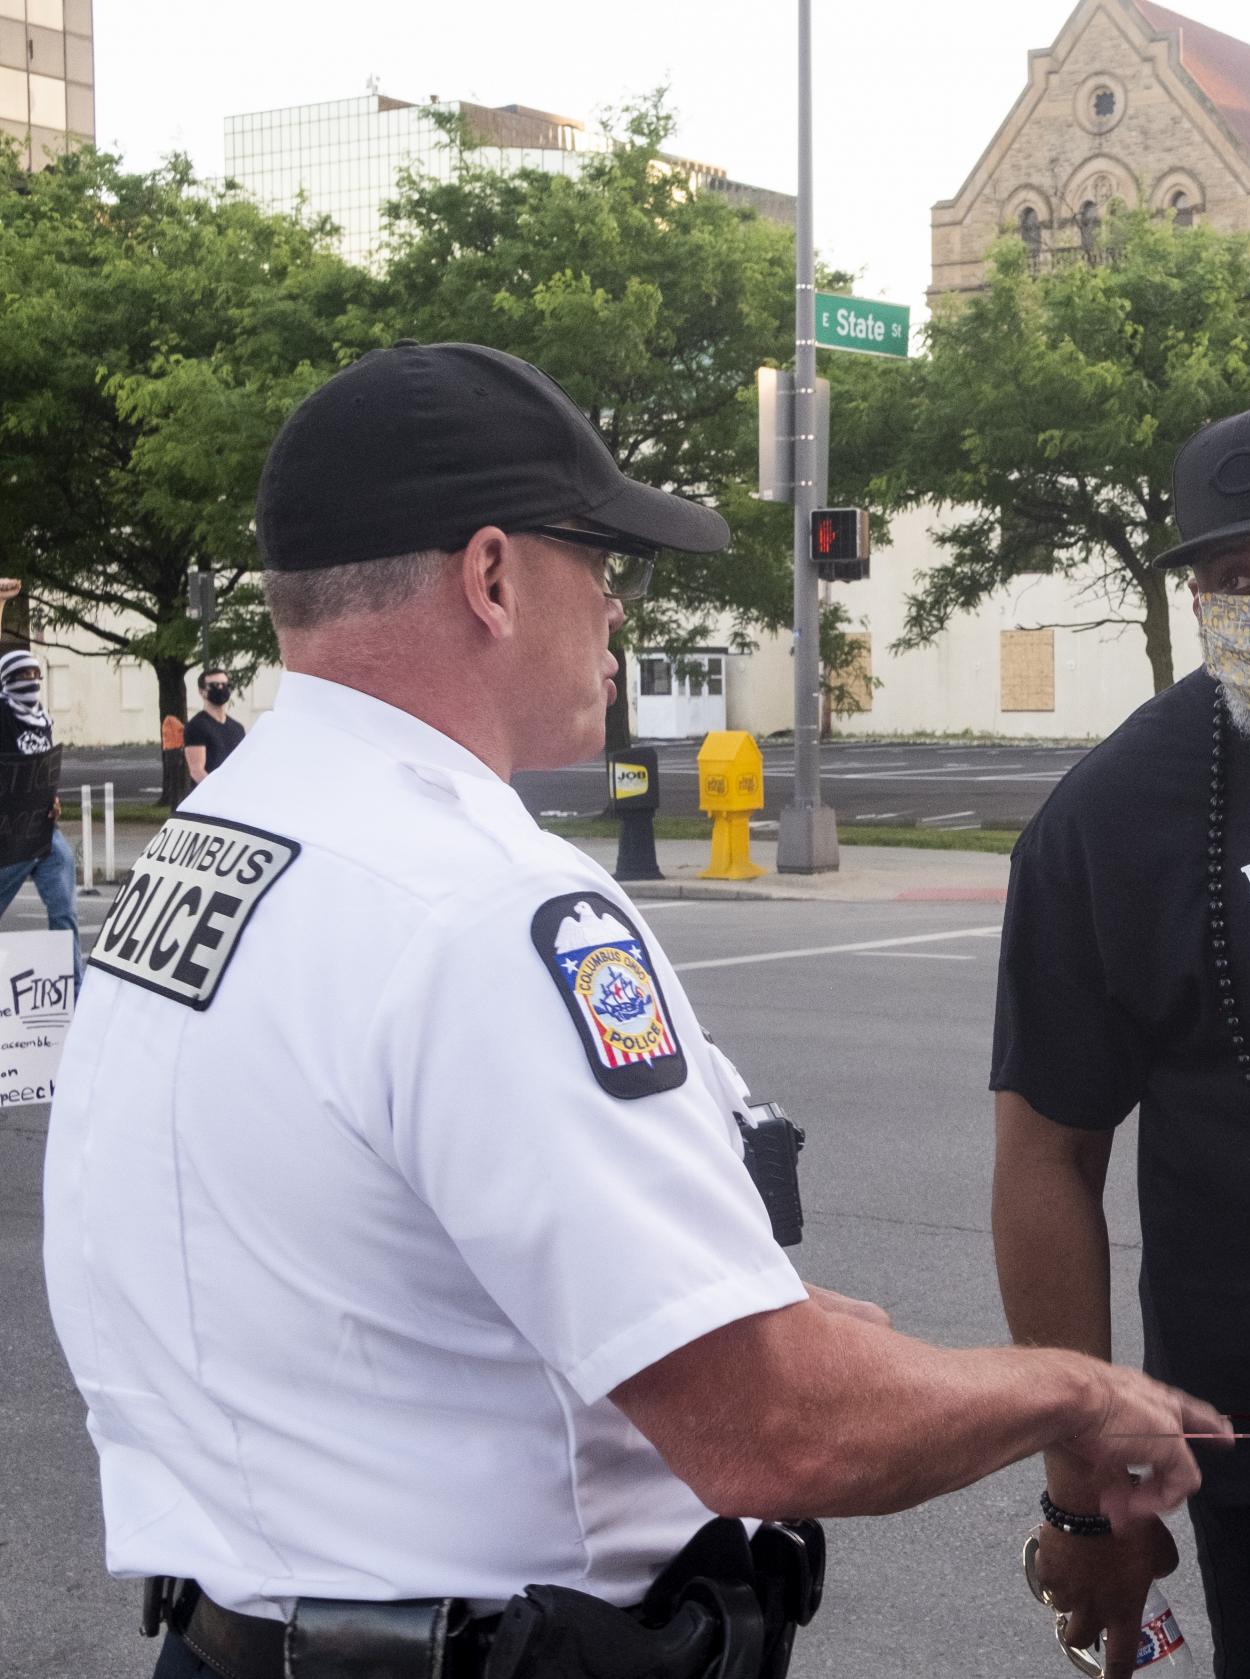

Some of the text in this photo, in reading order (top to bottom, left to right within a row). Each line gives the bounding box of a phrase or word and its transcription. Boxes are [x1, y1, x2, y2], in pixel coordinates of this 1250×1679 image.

[822, 308, 902, 341] E State St
[617, 771, 646, 780] JOB
[142, 827, 273, 885] OLUMBUS
[579, 949, 646, 992] COLUMBUS OHIO
[10, 968, 74, 1015] FIRST
[609, 1024, 661, 1051] POLICE
